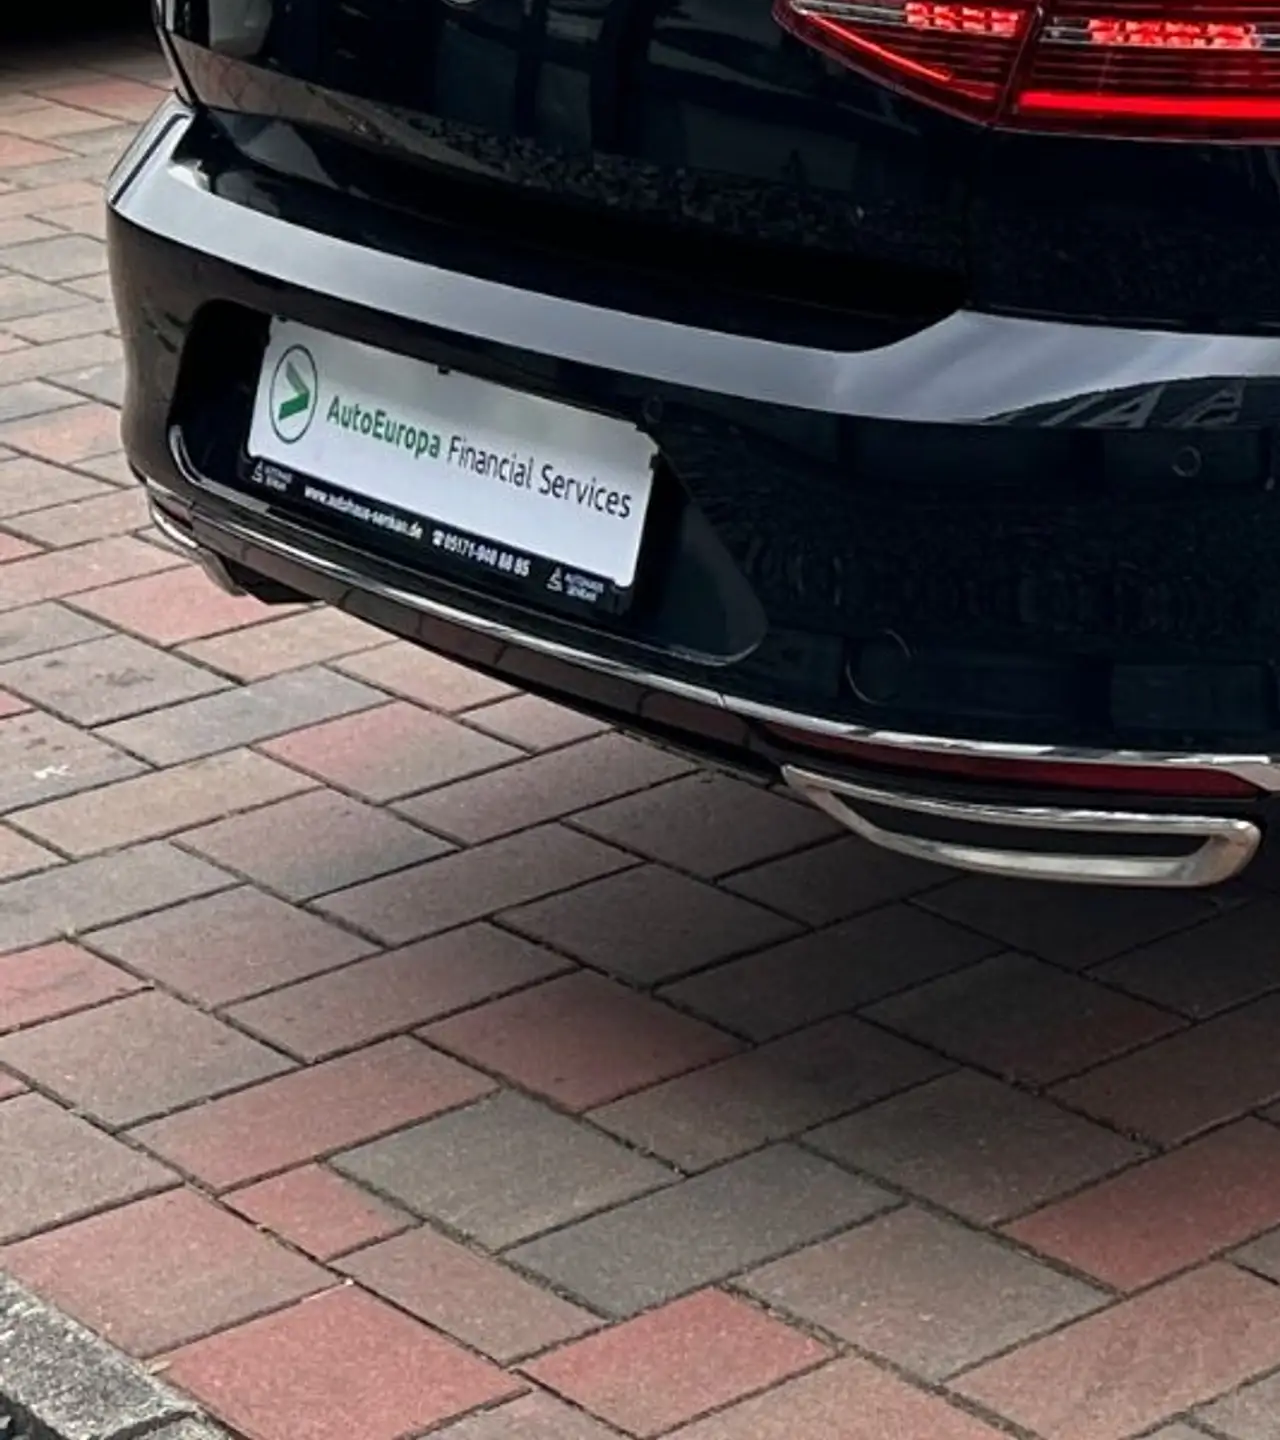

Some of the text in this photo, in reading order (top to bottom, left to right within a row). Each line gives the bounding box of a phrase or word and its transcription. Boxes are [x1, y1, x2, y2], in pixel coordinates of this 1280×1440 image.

[326, 396, 633, 519] AutoEuropa Financial Services
